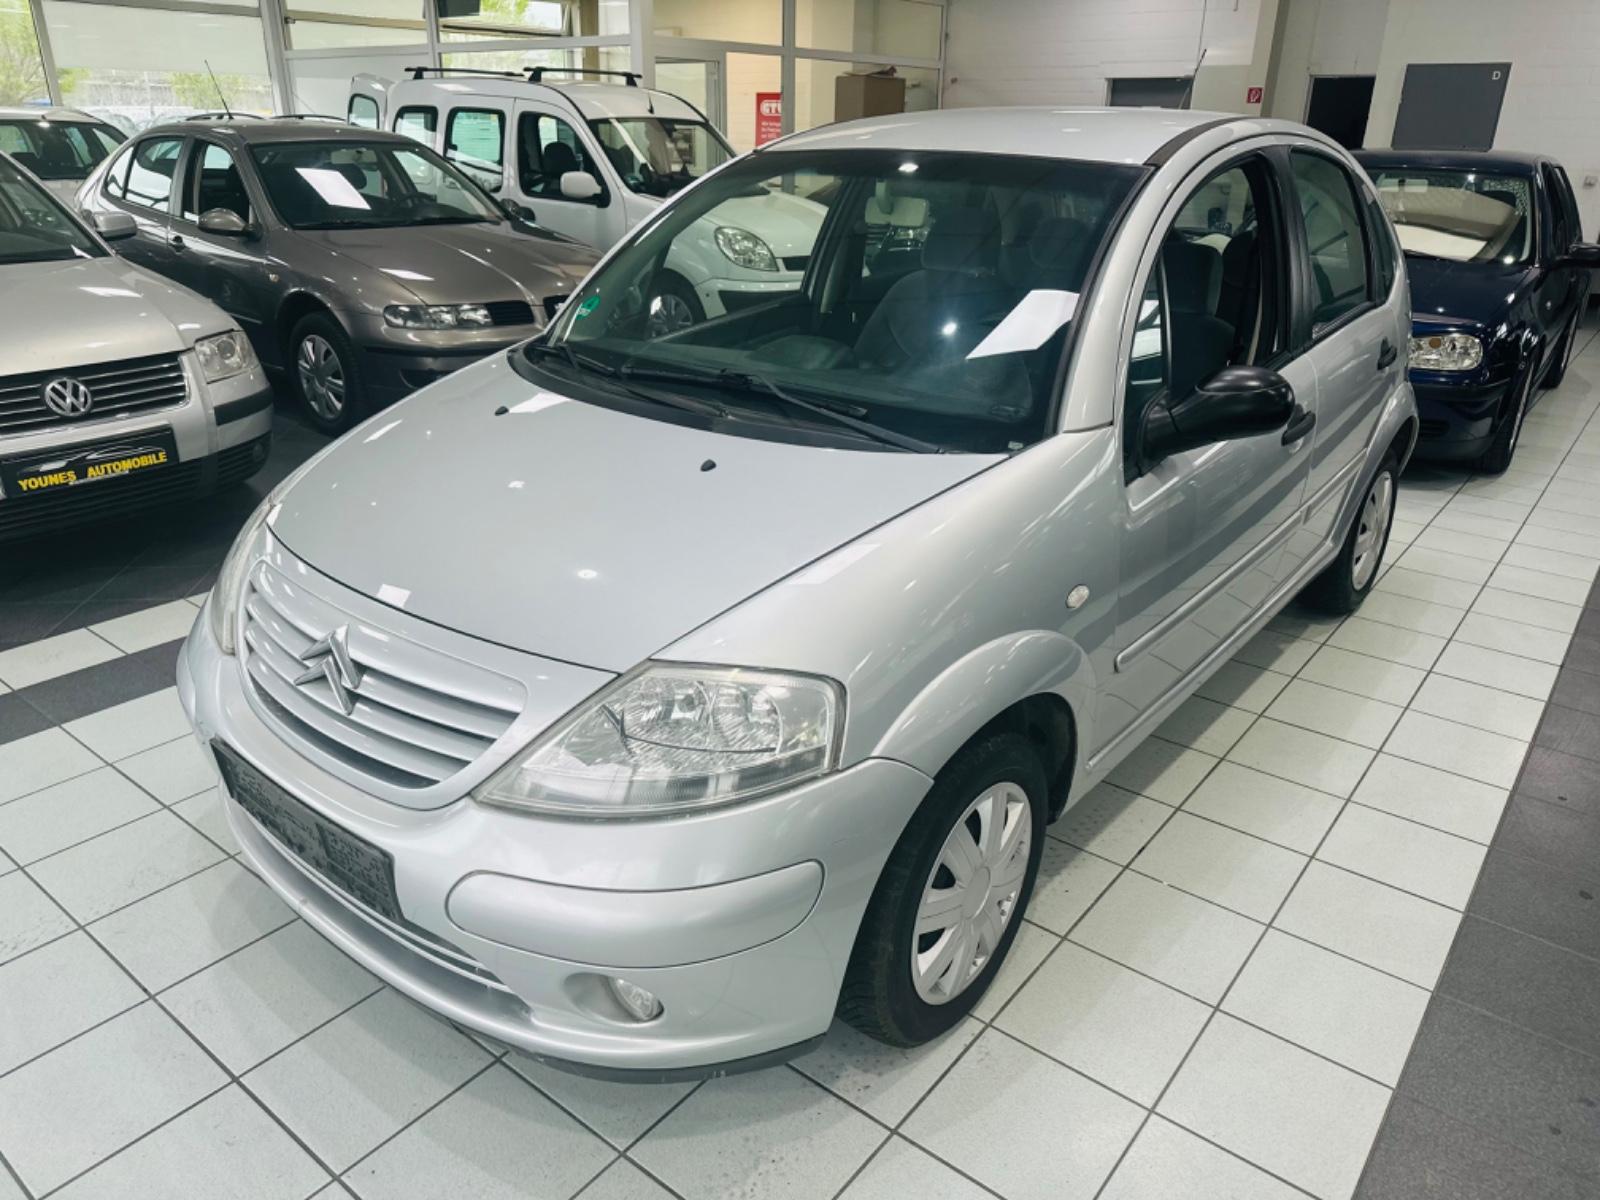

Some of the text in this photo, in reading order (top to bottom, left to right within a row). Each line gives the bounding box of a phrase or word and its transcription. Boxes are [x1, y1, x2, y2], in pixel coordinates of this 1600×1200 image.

[1492, 71, 1501, 80] D
[18, 452, 168, 491] YOUNES AUTOMOBILE
